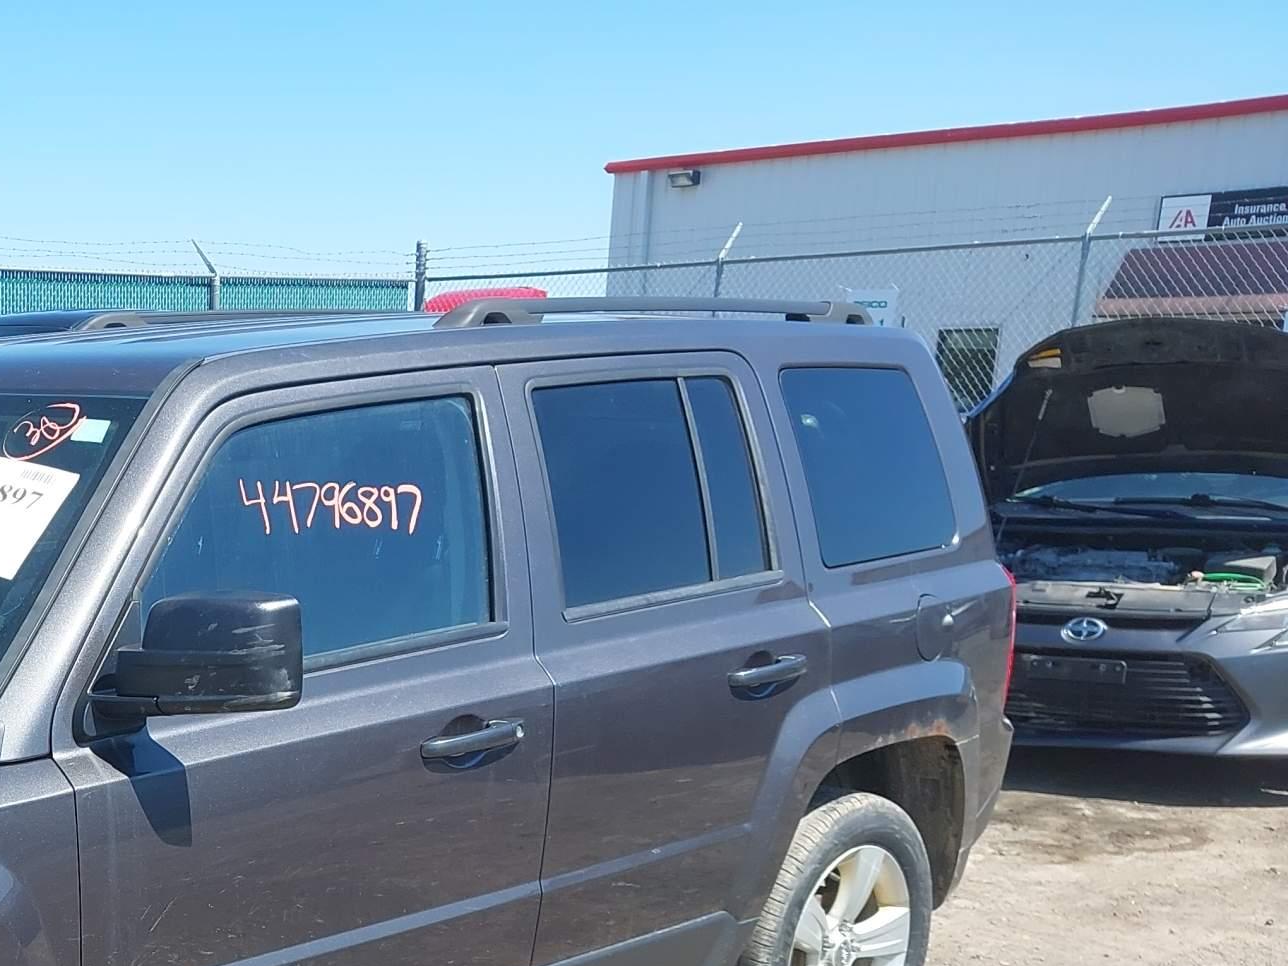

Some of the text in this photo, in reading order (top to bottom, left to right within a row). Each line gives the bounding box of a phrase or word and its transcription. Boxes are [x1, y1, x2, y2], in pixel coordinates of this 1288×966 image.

[1234, 202, 1286, 214] Insurance
[1223, 216, 1246, 227] Auto
[239, 478, 422, 535] 44796897
